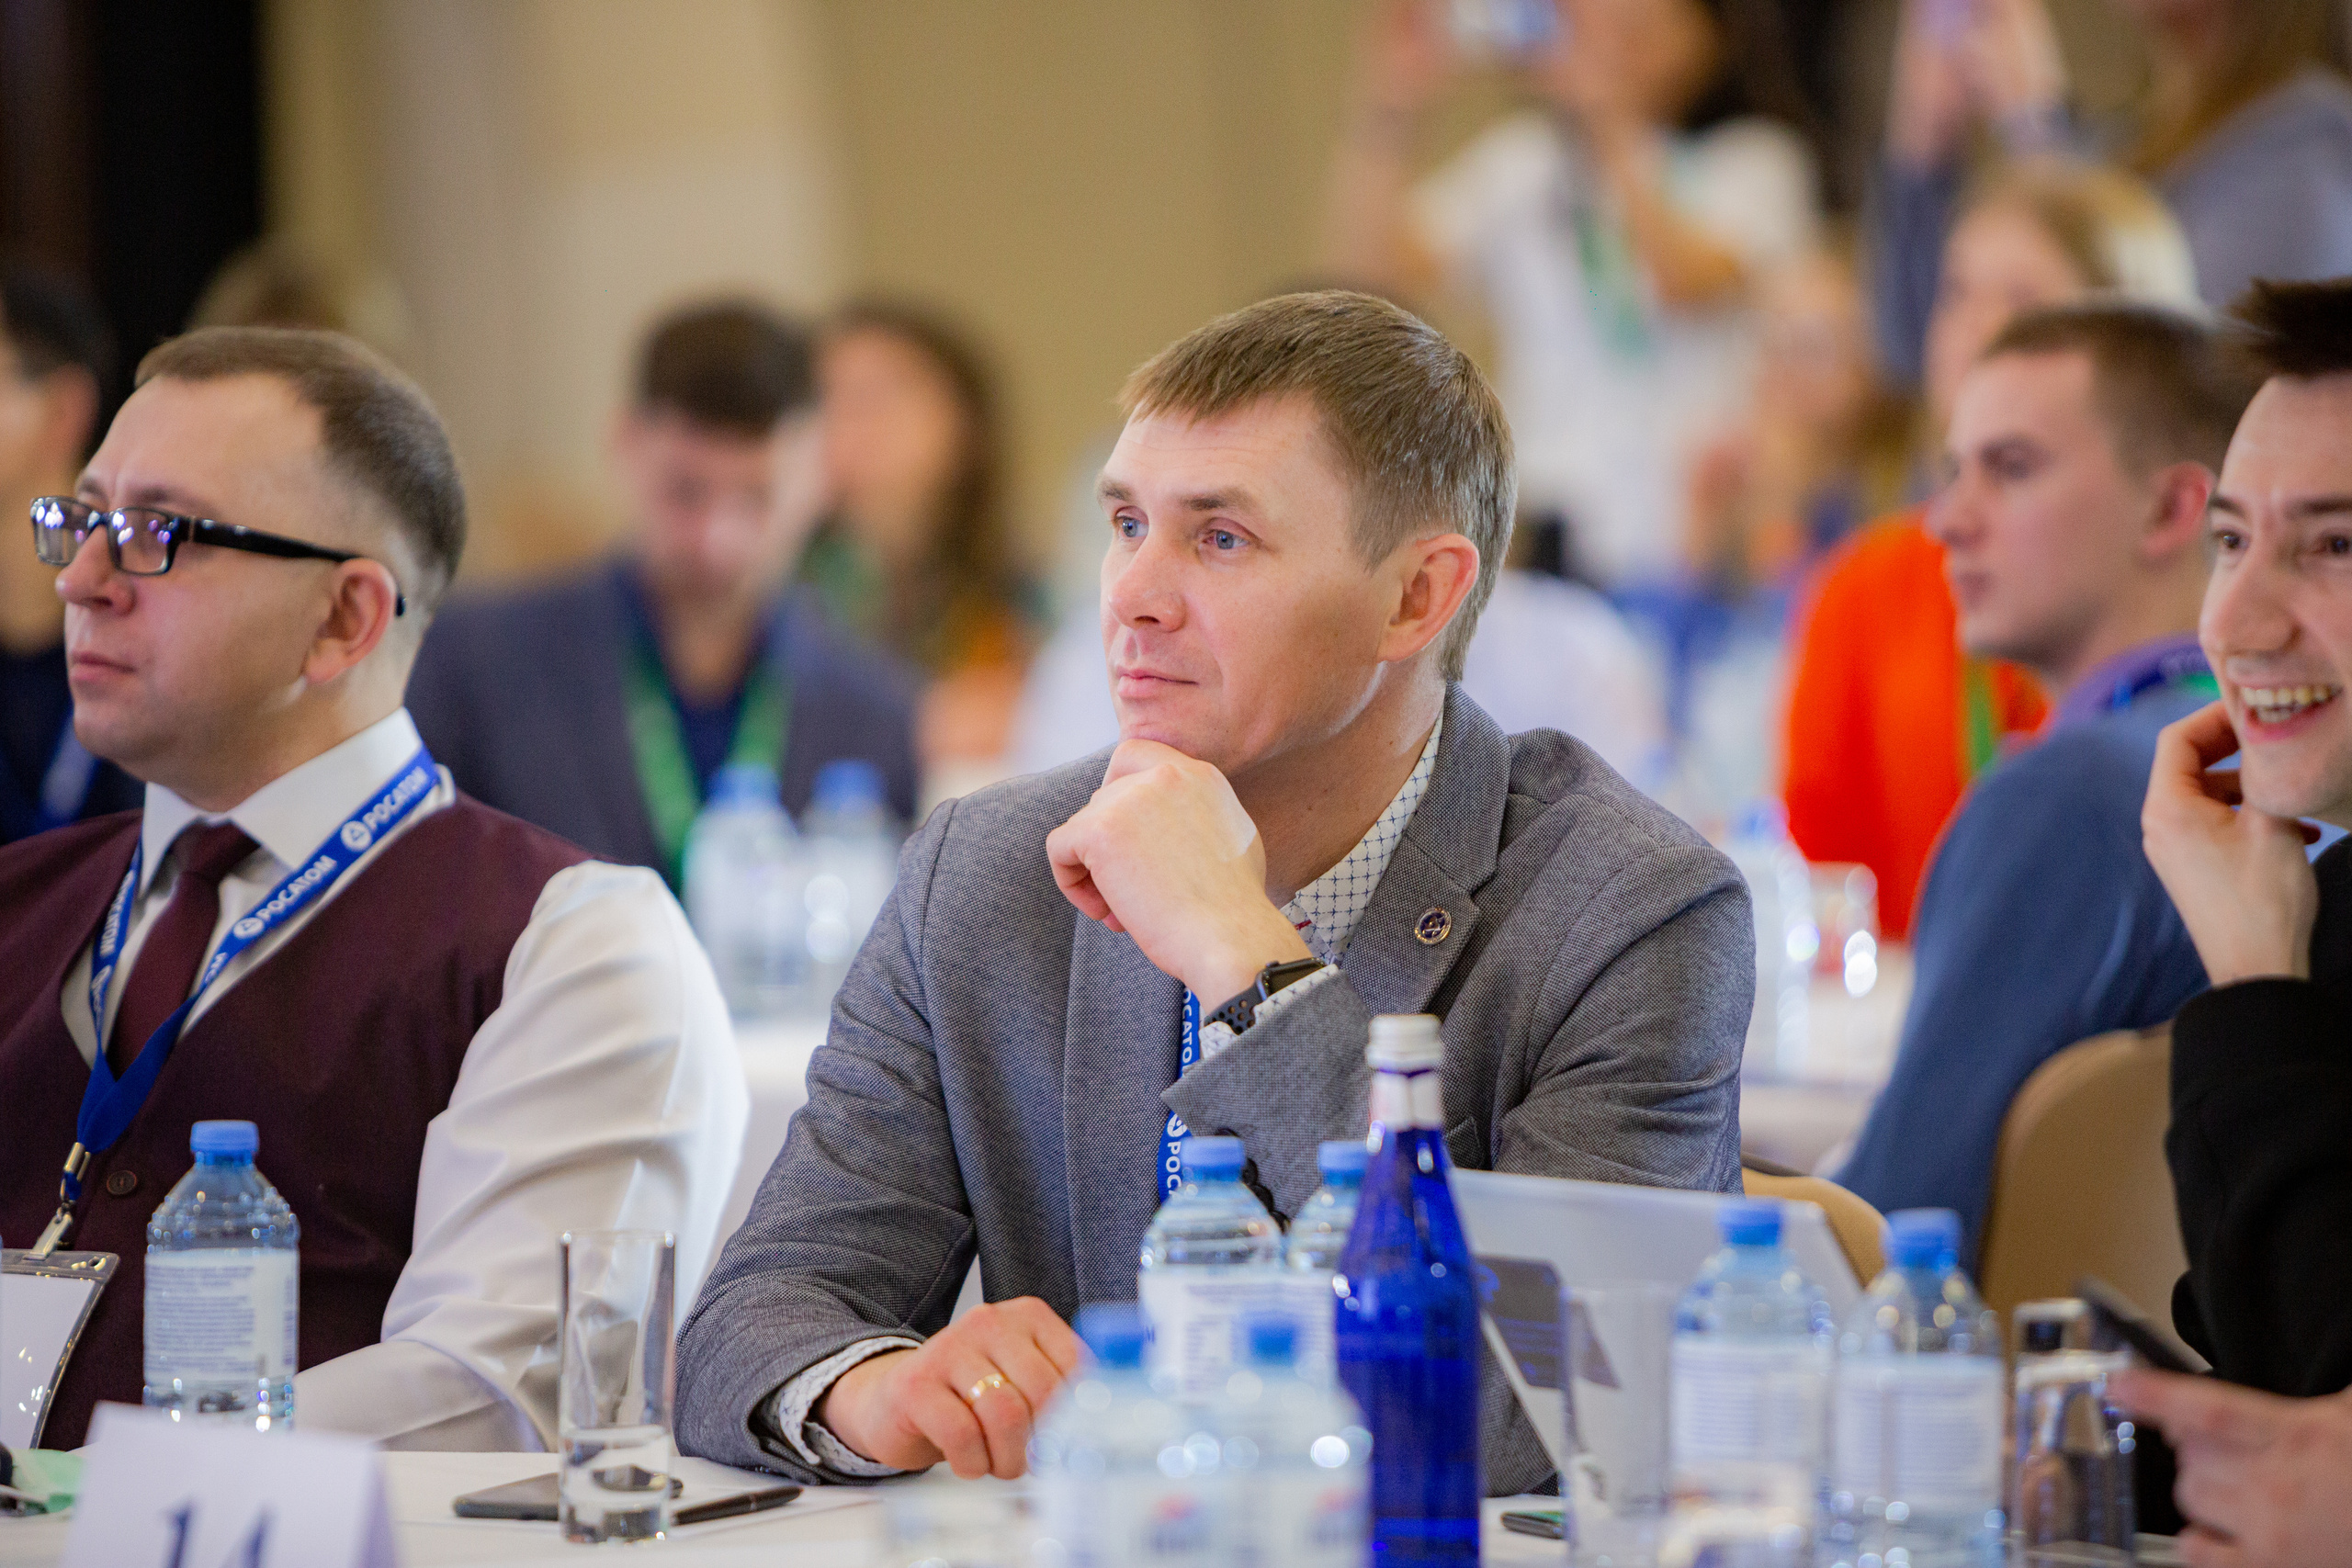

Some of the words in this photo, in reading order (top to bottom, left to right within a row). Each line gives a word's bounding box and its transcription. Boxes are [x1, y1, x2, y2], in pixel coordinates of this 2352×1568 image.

[362, 765, 429, 832] РОСАТОМ
[254, 854, 338, 922] РОСАТОМ
[1182, 987, 1193, 1076] ОСАТО
